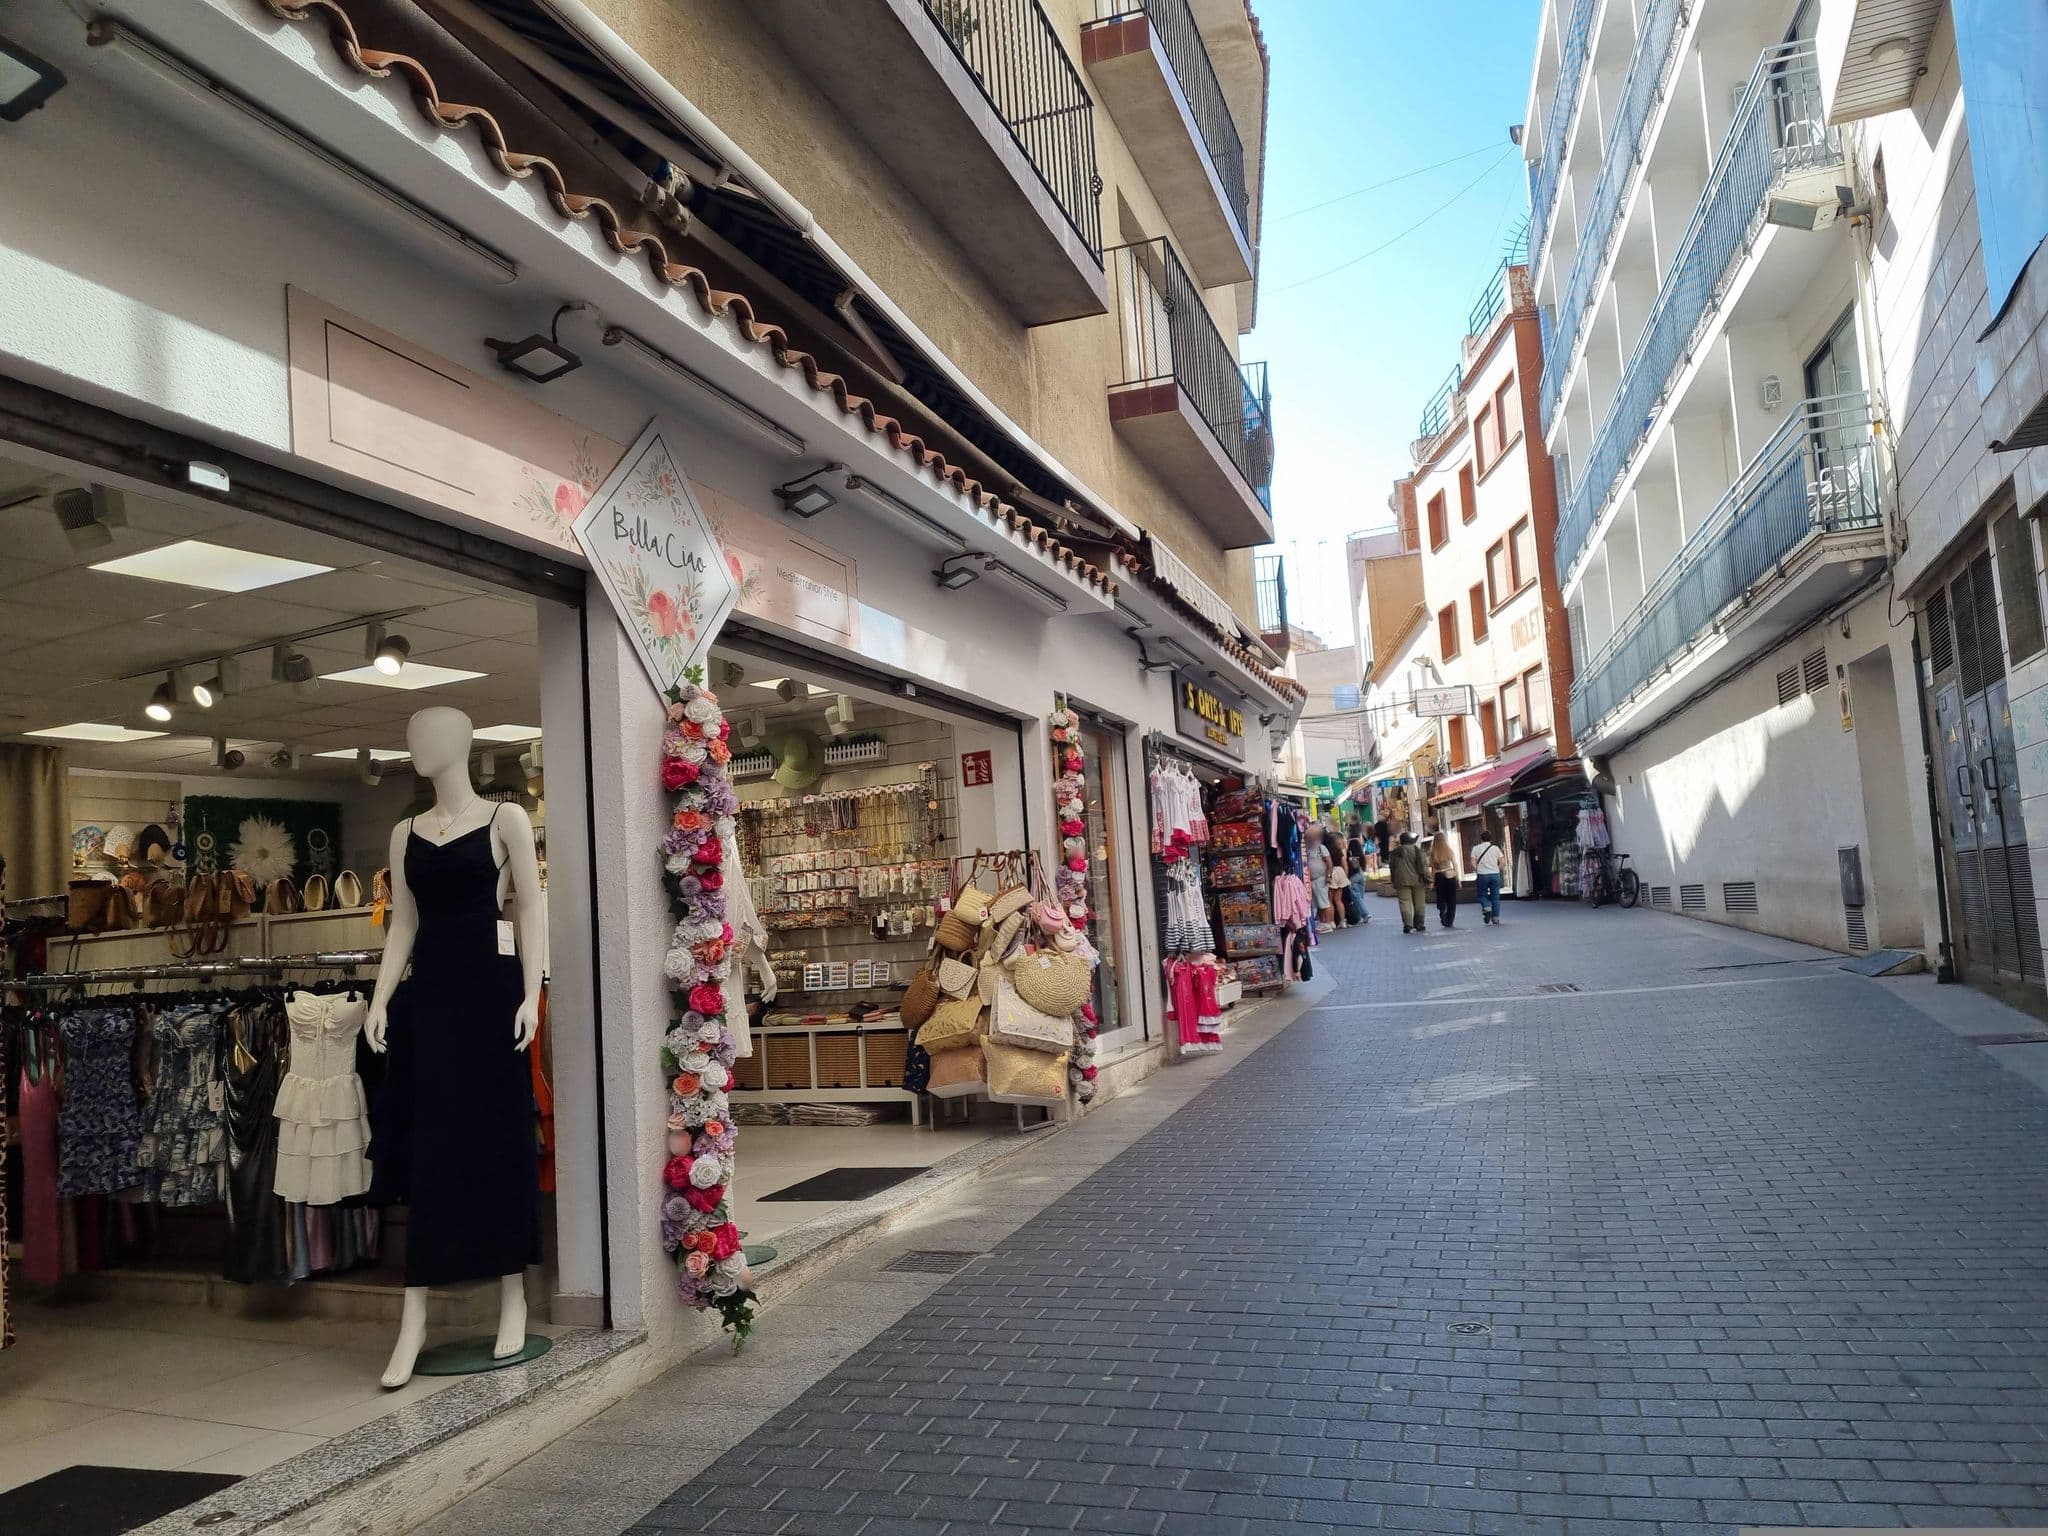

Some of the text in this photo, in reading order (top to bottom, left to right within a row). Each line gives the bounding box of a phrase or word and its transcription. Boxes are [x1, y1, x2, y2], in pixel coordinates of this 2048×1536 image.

[613, 505, 707, 573] Bella Ciao
[823, 584, 839, 602] Style
[1187, 681, 1219, 723] SORTS
